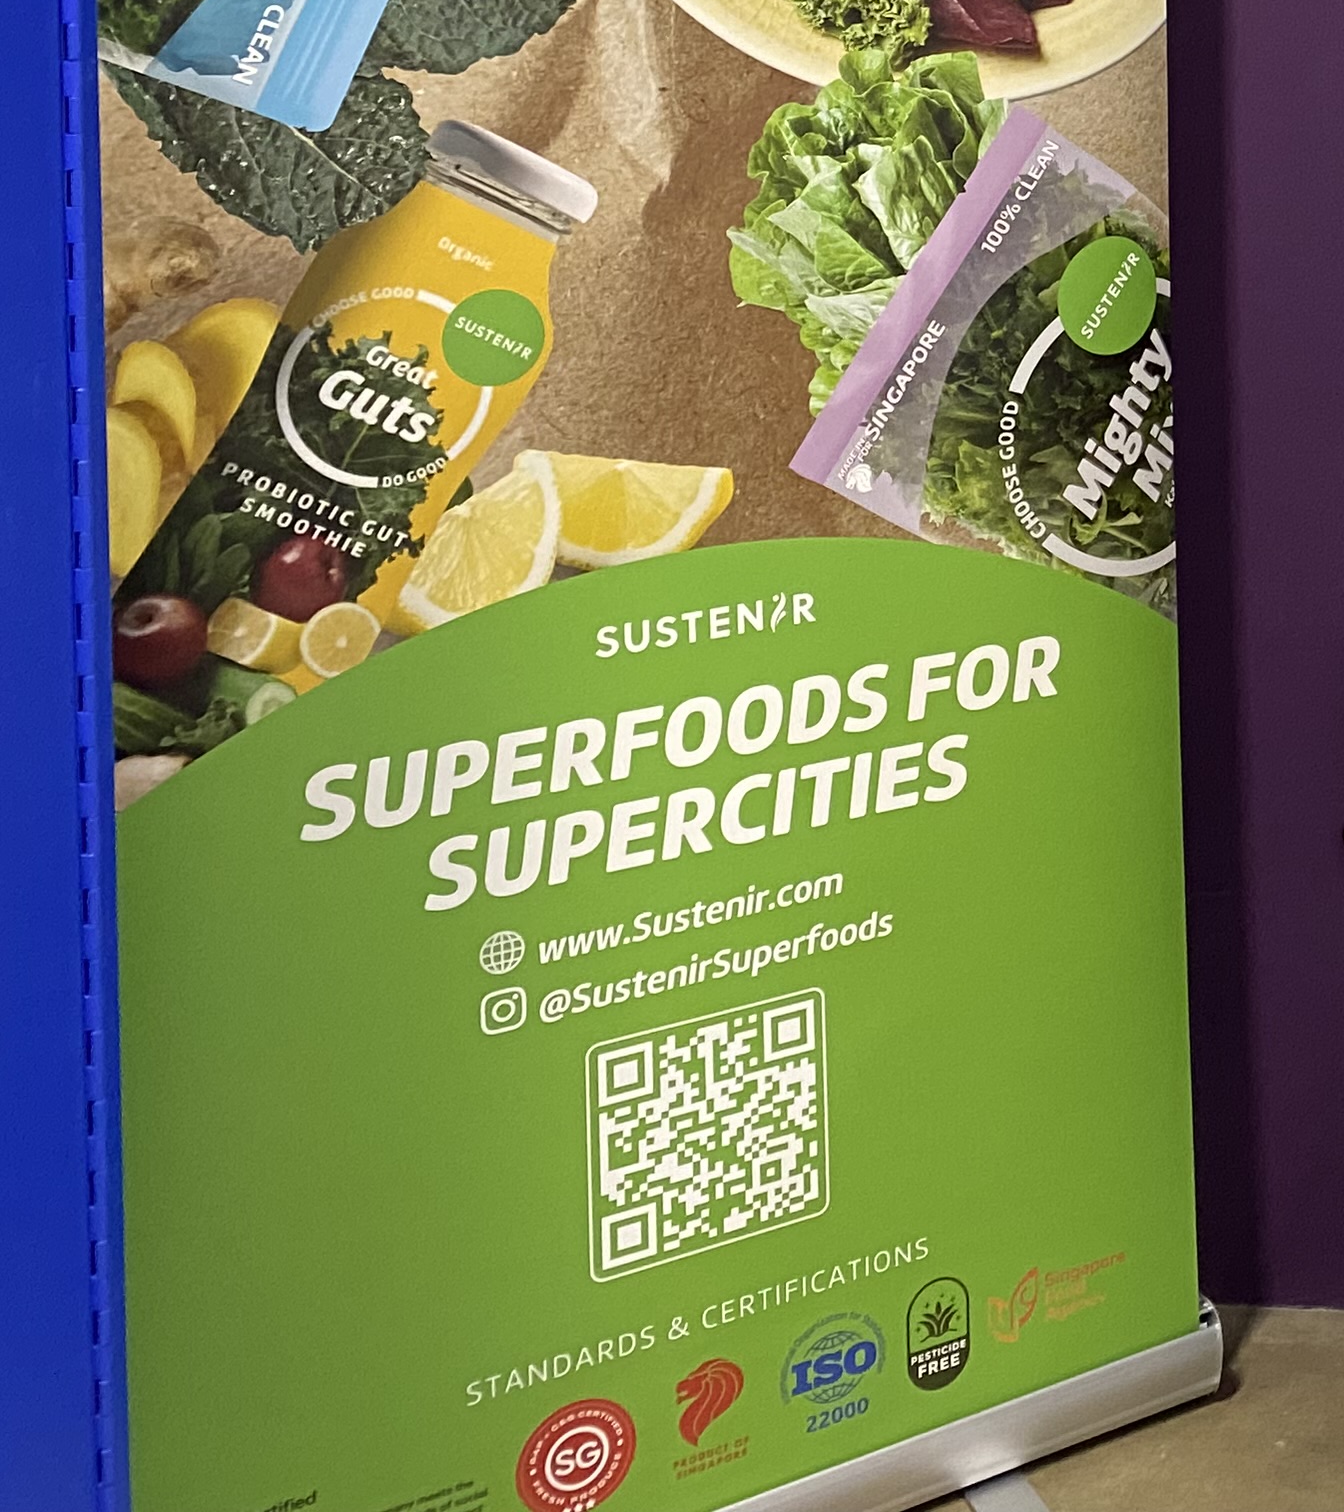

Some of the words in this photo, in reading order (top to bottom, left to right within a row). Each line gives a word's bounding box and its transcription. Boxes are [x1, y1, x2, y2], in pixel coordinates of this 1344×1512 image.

[980, 203, 1023, 255] 100%
[1014, 138, 1062, 203] CLEAN
[1080, 250, 1141, 340] SUSTENIR
[364, 344, 440, 390] Great
[454, 315, 534, 361] SUSTENIR
[864, 318, 947, 440] SINGAPORE
[317, 369, 437, 444] Guts
[1062, 328, 1172, 521] Mighty
[220, 461, 356, 529] PROBIOTIC
[360, 517, 411, 550] GUT
[238, 495, 366, 559] SMOOTHIE
[594, 591, 818, 660] SUSTENIR
[299, 660, 890, 843] SUPERFOODS
[906, 634, 1063, 723] FOR
[424, 733, 971, 912] SUPERCITIES
[537, 870, 845, 966] www.Sustenir.com
[539, 910, 895, 1025] @SustenirSuperfoods
[463, 1325, 661, 1407] STANDARDS
[667, 1312, 693, 1342] &
[699, 1237, 931, 1332] CERTIFICATIONS
[909, 1337, 967, 1367] PESTICIDE
[790, 1340, 878, 1398] ISO
[916, 1352, 961, 1380] FREE
[806, 1397, 870, 1434] 22000
[553, 1440, 601, 1477] SG
